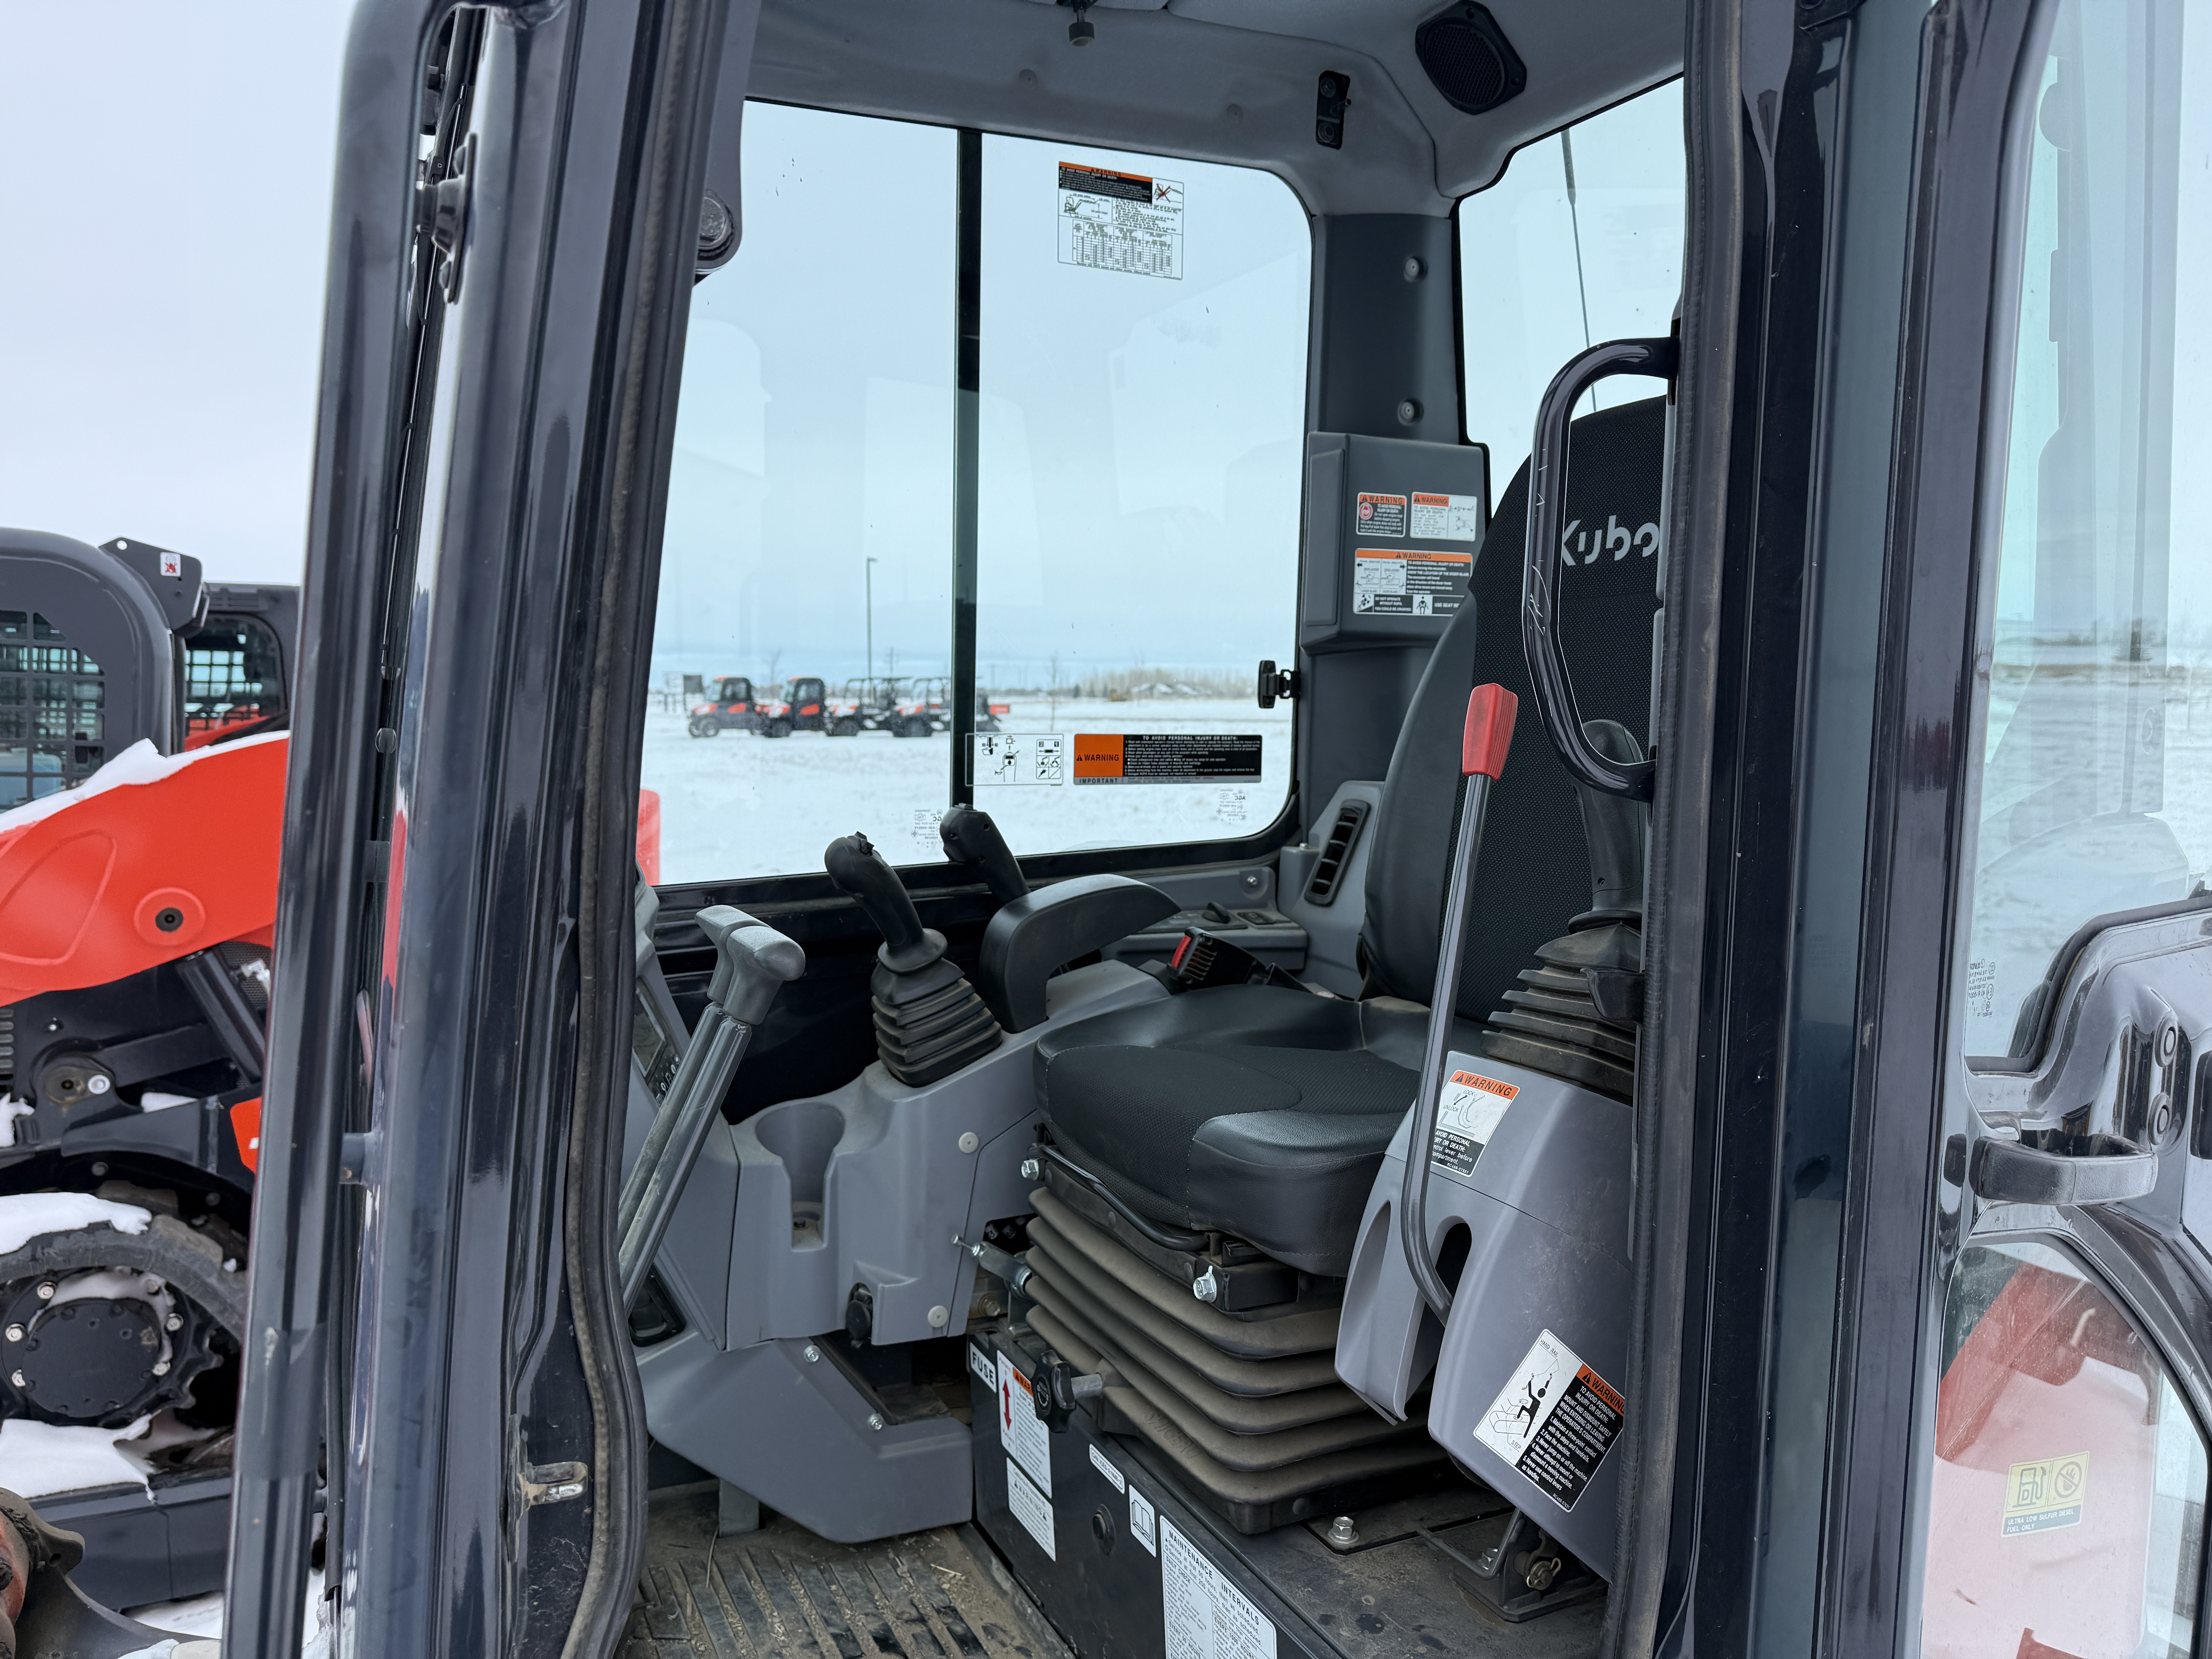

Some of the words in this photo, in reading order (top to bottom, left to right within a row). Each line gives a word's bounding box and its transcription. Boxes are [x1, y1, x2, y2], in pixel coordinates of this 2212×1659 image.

[1370, 495, 1402, 505] WARNING
[1562, 515, 1659, 566] Kubo
[1465, 1077, 1512, 1096] WARNING
[1443, 1104, 1459, 1113] UNLOCK
[1444, 1147, 1456, 1156] lever
[1458, 1152, 1472, 1162] before
[1448, 1134, 1470, 1146] PERSONAL
[1449, 1142, 1465, 1152] DEATH:
[1540, 1340, 1550, 1350] HAND
[1549, 1348, 1558, 1357] RAIL
[972, 1352, 994, 1384] FUSE
[1576, 1393, 1590, 1406] INJURY
[1595, 1409, 1608, 1423] DEATH:
[1585, 1391, 1597, 1403] AVOID
[1597, 1401, 1616, 1420] PERSONAL
[1592, 1377, 1625, 1413] WARNING
[1556, 1408, 1564, 1417] THE
[1582, 1431, 1606, 1453] COMPARTMENT.
[1560, 1401, 1571, 1413] WHEN
[1570, 1410, 1587, 1426] ENTERING
[1590, 1428, 1605, 1442] LEAVING
[1564, 1395, 1577, 1407] MOUNT
[1575, 1405, 1584, 1413] AND
[1583, 1411, 1600, 1427] DISMOUNT
[1599, 1425, 1612, 1437] SAFELY
[1511, 1441, 1521, 1449] STEP
[1544, 1432, 1552, 1441] Face
[1557, 1444, 1570, 1457] machine.
[1553, 1418, 1566, 1432] Maintain
[1568, 1432, 1585, 1448] three-point
[1585, 1446, 1597, 1458] contact
[1560, 1436, 1570, 1445] steps
[1575, 1447, 1589, 1462] handrails.
[1526, 1458, 1536, 1468] Never
[1541, 1472, 1554, 1483] control
[1552, 1480, 1562, 1491] levers
[1531, 1452, 1546, 1467] dismount
[1547, 1467, 1559, 1479] moving
[1559, 1476, 1572, 1489] machine.
[1534, 1445, 1545, 1455] Never
[1544, 1454, 1557, 1466] attempt
[1559, 1467, 1570, 1477] mount
[1539, 1438, 1549, 1449] Never
[1547, 1446, 1557, 1456] jump
[1574, 1469, 1587, 1482] machine.
[2039, 1512, 2057, 1520] SULFUR
[1166, 1555, 1176, 1569] DAILY
[1178, 1568, 1190, 1584] CHECK
[1169, 1530, 1212, 1579] MAINTENANCE
[1221, 1582, 1259, 1625] INTERVALS
[1168, 1539, 1182, 1556] Service
[1198, 1570, 1203, 1578] 50
[1205, 1576, 1217, 1593] hours,
[1219, 1591, 1228, 1604] then
[1230, 1603, 1235, 1611] as
[1237, 1610, 1259, 1635] scheduled.
[1168, 1548, 1182, 1565] Service
[1207, 1587, 1220, 1604] hours,
[1221, 1602, 1231, 1615] then
[1232, 1614, 1238, 1622] as
[1240, 1621, 1262, 1647] scheduled.
[1214, 1616, 1227, 1633] EVERY
